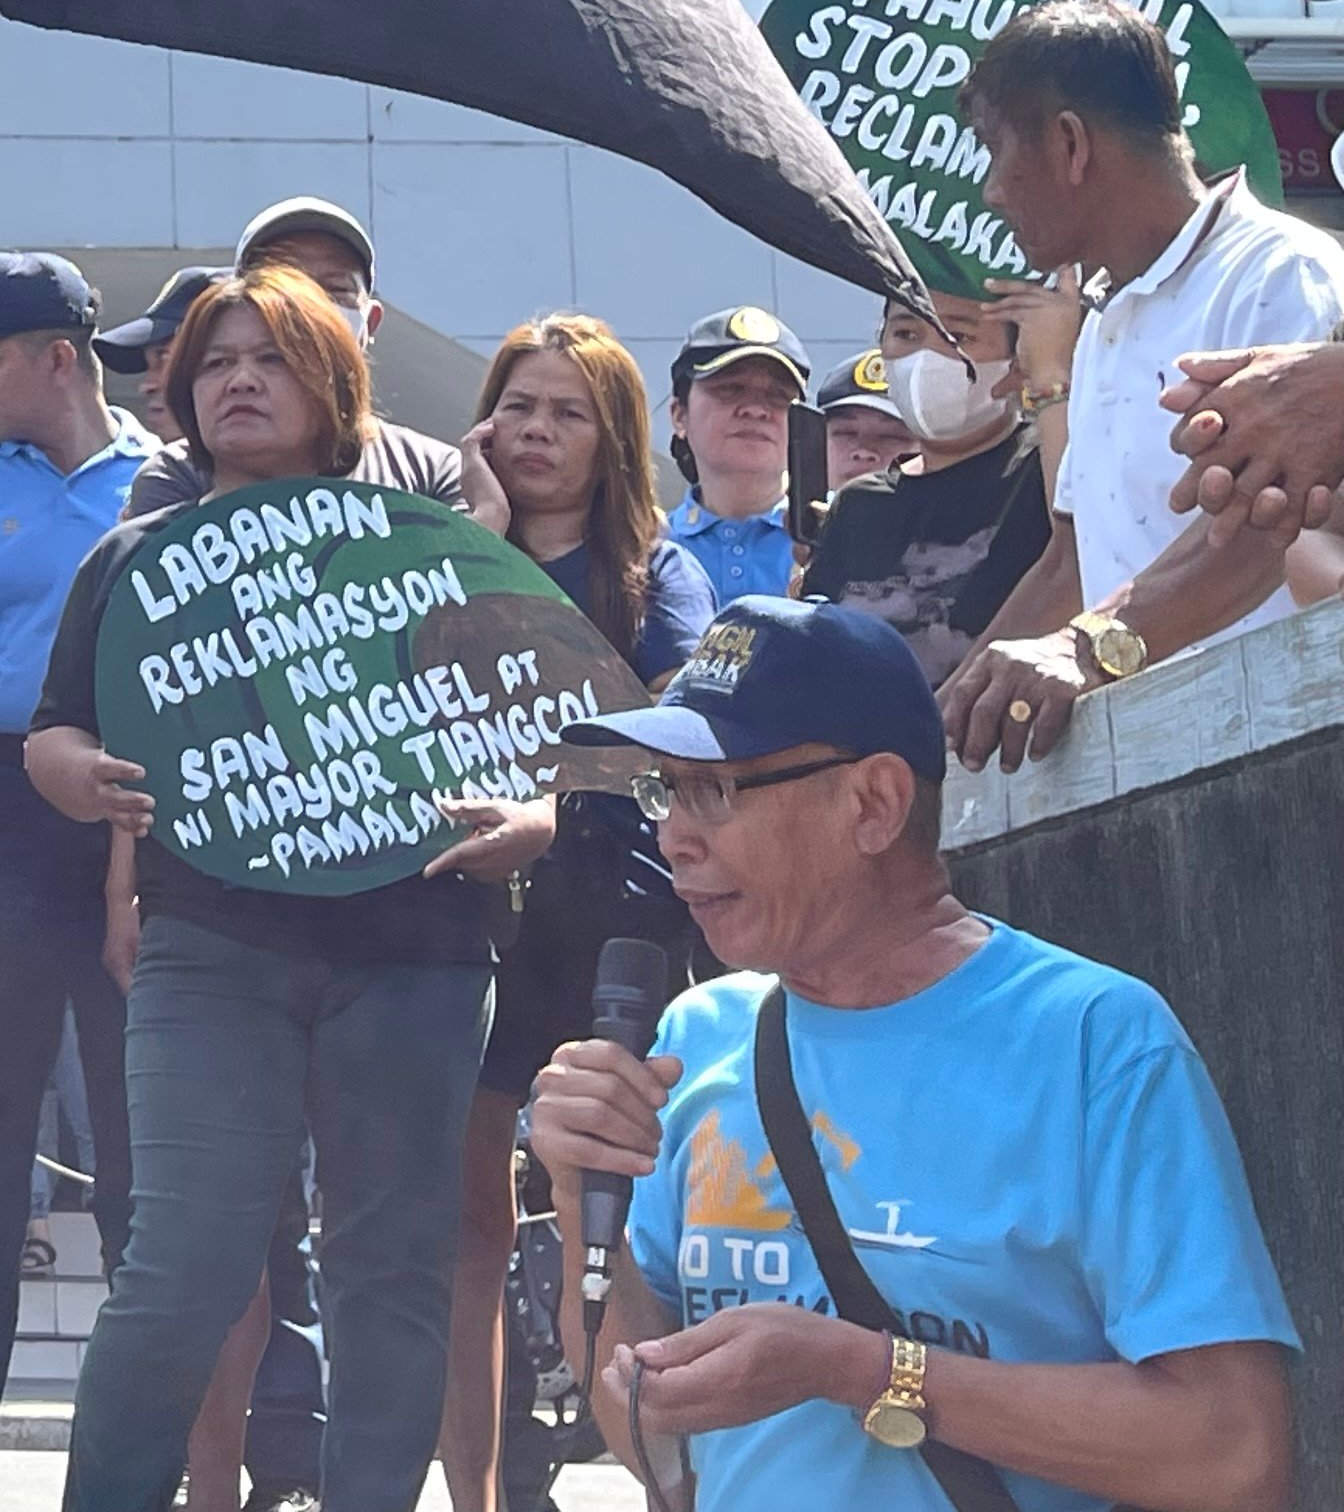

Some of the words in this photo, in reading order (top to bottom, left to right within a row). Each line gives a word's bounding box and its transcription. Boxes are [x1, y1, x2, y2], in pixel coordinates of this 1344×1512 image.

[794, 5, 972, 99] STOP
[798, 68, 993, 185] RECLAM
[130, 487, 393, 624] LABANAN
[229, 551, 318, 621] ANG
[138, 557, 469, 716] REKLAMASYON
[284, 646, 359, 707] NG
[179, 723, 292, 803] SAN
[302, 661, 491, 762] MIGUEL
[496, 648, 541, 695] AT
[223, 749, 398, 840] MAYOR
[723, 1238, 791, 1285] TO
